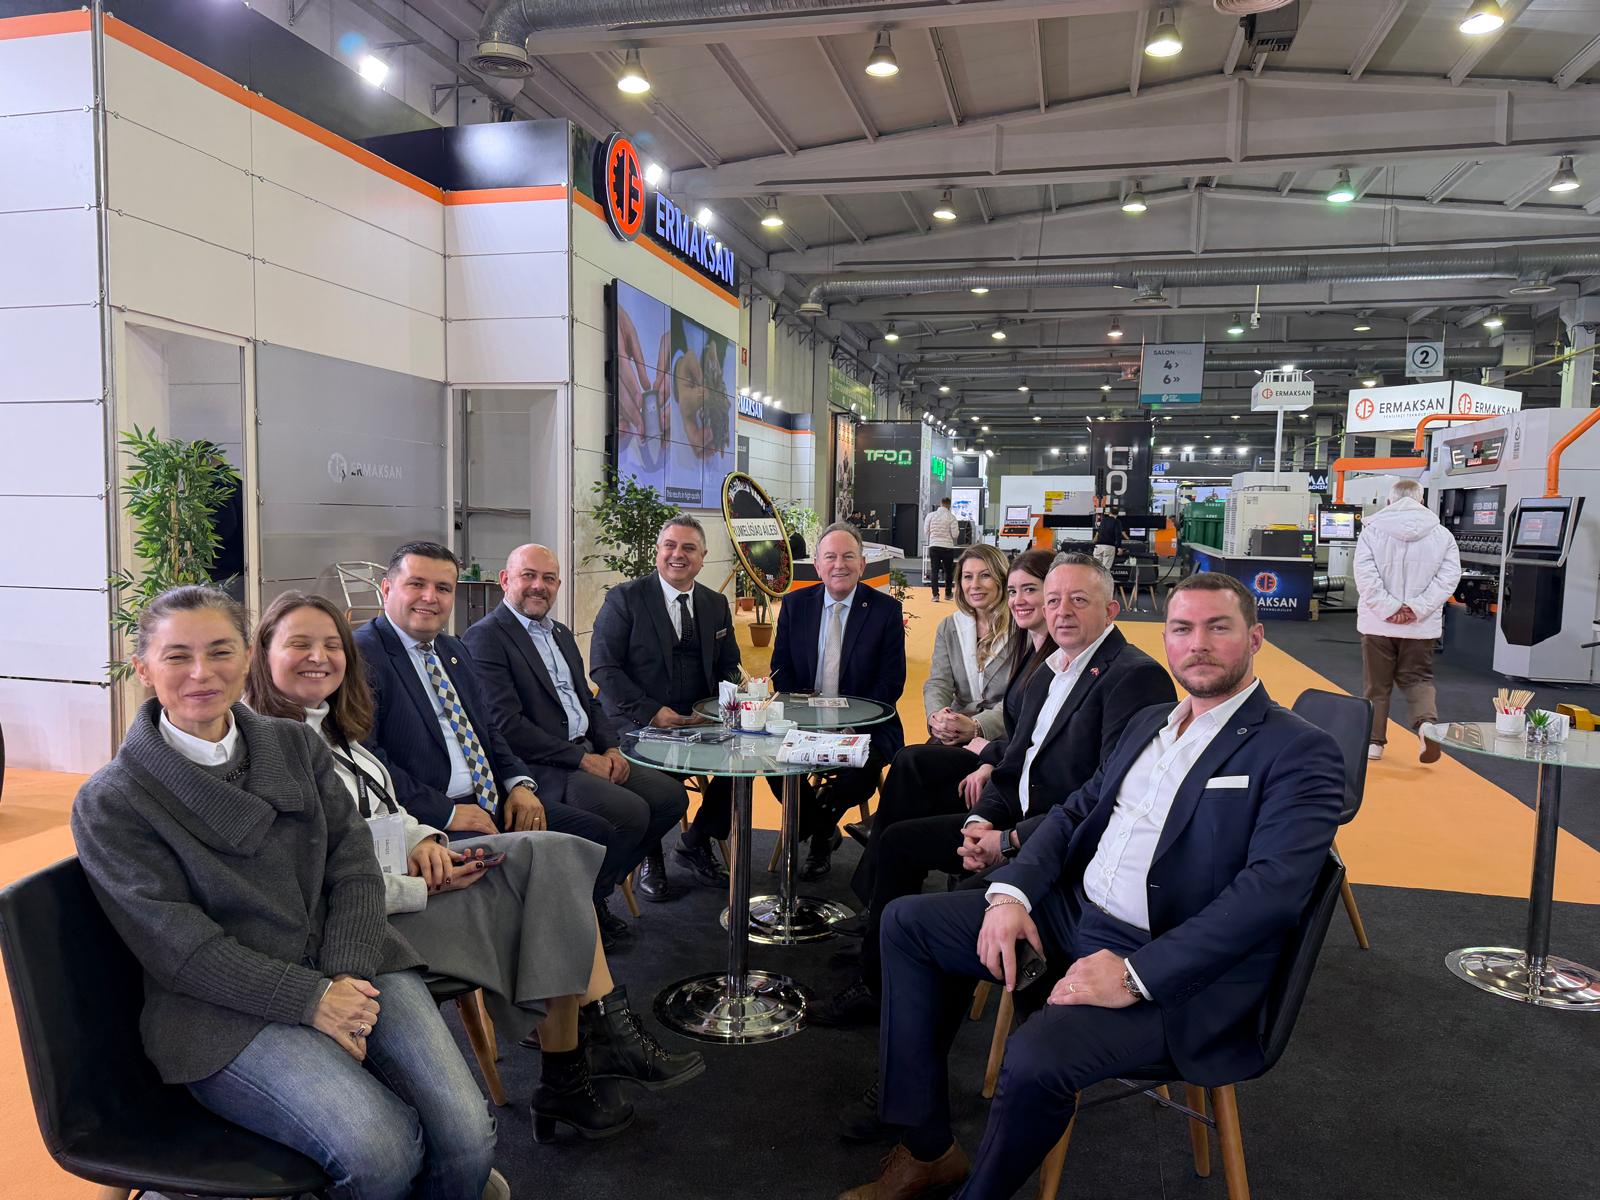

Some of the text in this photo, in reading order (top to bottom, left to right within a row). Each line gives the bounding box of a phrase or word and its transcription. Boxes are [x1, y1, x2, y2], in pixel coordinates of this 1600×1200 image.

[655, 192, 735, 287] ERMAKSAN
[1163, 360, 1173, 370] 4
[1419, 350, 1430, 365] 2
[1163, 374, 1172, 385] 6
[1378, 397, 1445, 414] ERMAKSAN
